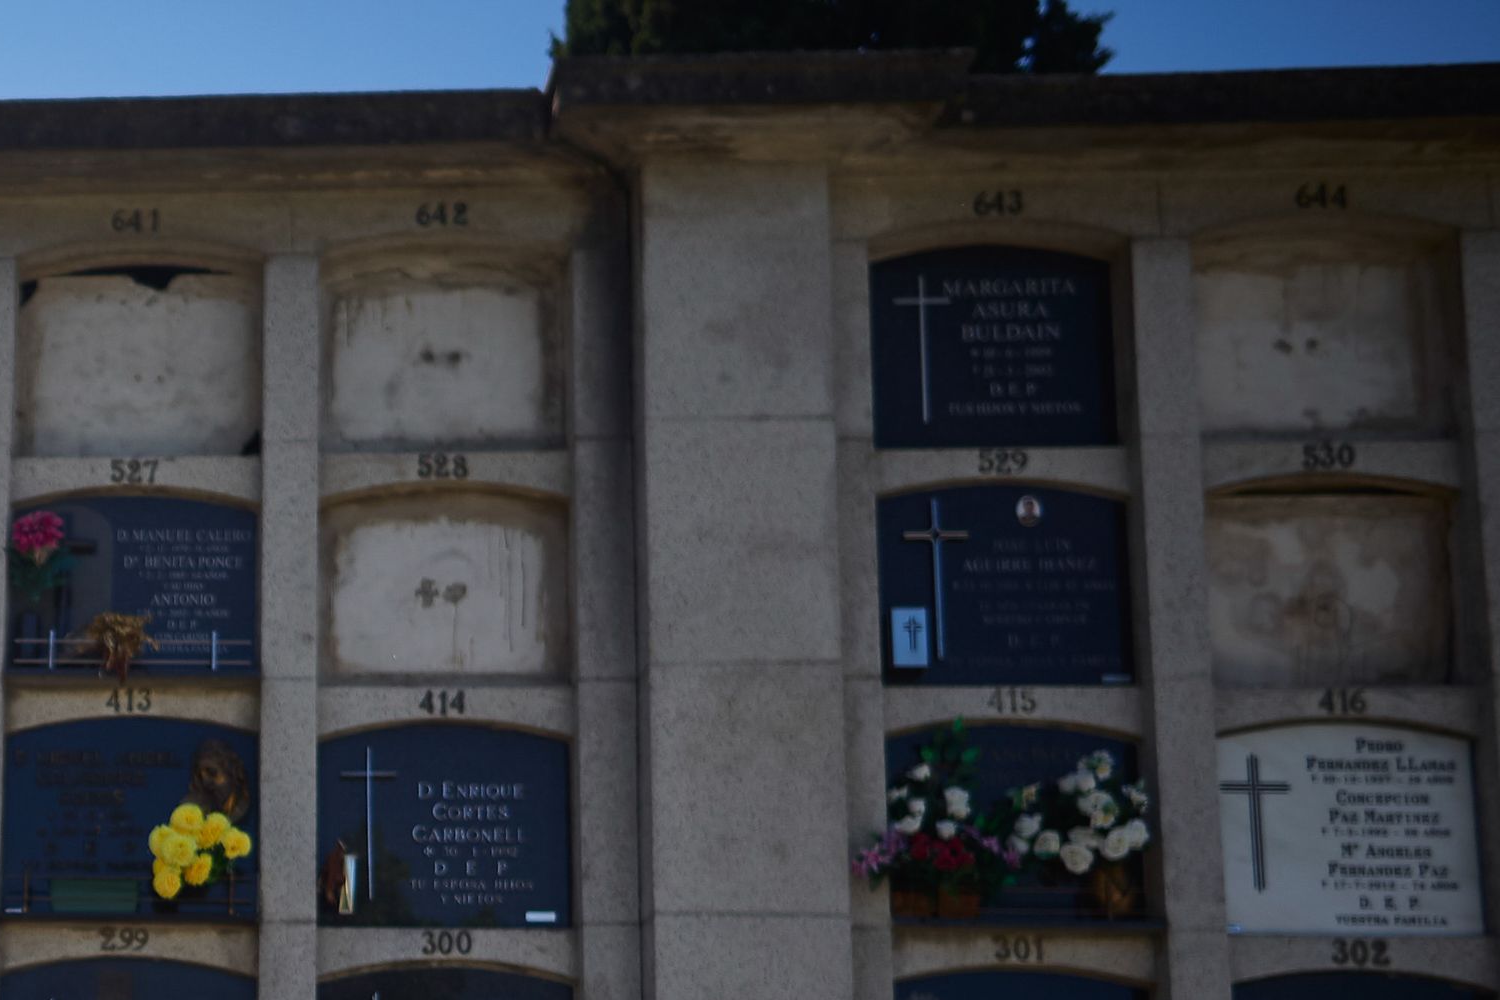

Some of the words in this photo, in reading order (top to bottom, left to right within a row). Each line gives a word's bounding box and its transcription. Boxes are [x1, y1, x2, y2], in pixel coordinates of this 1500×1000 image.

[416, 200, 469, 227] 642
[973, 190, 1023, 215] 643
[111, 208, 161, 233] 641
[418, 453, 468, 477] 528
[978, 450, 1028, 475] 529
[1303, 442, 1356, 469] 530
[110, 459, 159, 483] 527
[105, 687, 151, 712] 413
[419, 690, 466, 714] 414
[987, 688, 1037, 714] 415
[1318, 688, 1367, 714] 416
[100, 926, 149, 950] 299
[421, 931, 472, 954] 300
[992, 935, 1045, 961] 301
[1331, 937, 1391, 966] 302
